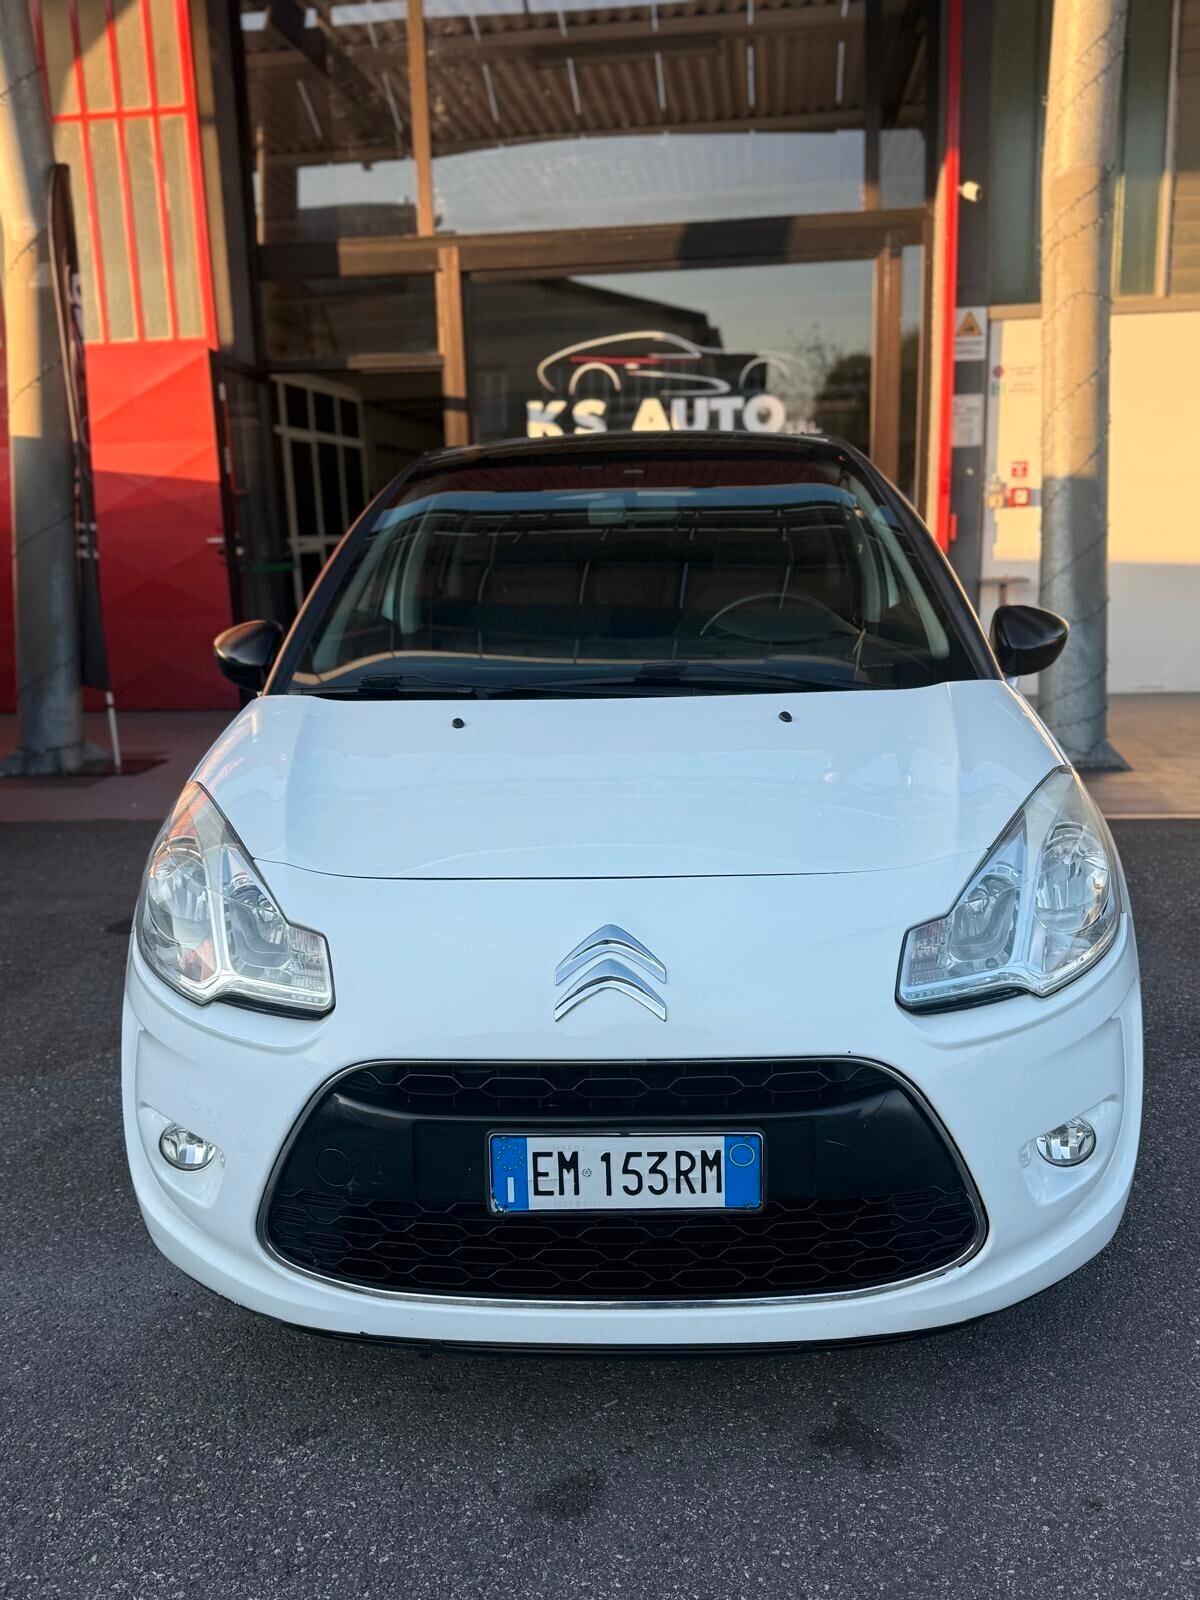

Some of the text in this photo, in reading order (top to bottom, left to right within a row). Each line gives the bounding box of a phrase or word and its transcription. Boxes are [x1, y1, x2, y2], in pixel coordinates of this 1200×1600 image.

[526, 394, 786, 438] KS AUTO
[532, 1149, 723, 1196] EM 153RM
